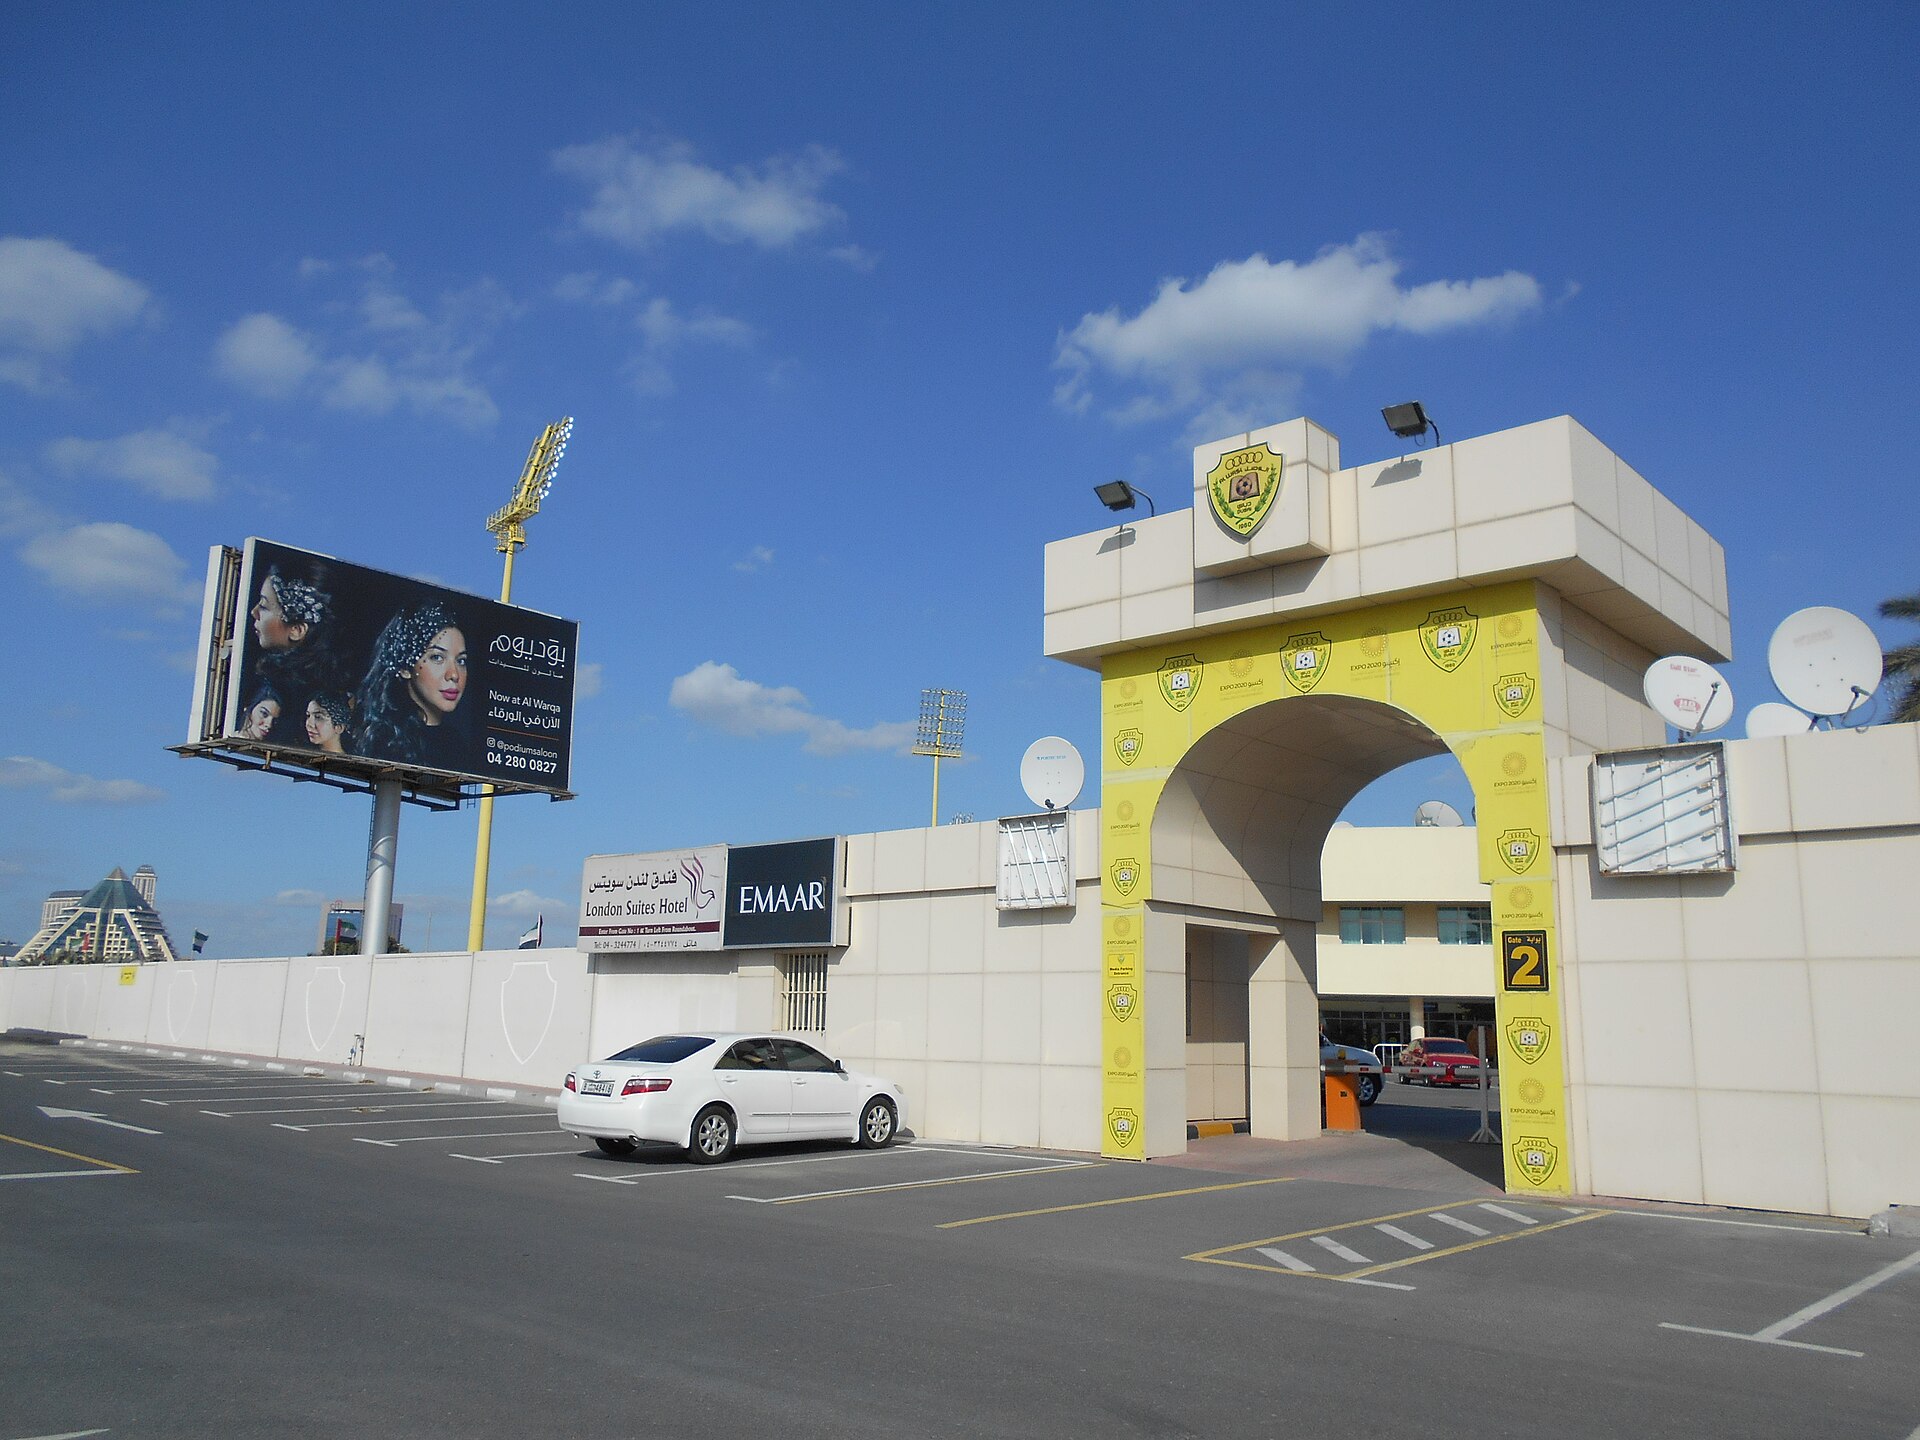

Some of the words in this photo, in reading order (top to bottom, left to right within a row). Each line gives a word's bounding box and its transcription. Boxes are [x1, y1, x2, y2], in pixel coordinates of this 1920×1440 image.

[489, 690, 510, 702] Now
[512, 696, 520, 705] at
[533, 699, 560, 714] Warqa
[488, 706, 521, 722] الورقاء
[522, 715, 540, 727] في
[542, 717, 560, 729] الآن
[497, 740, 558, 758] @podiumsaloon
[487, 752, 502, 764] 04
[505, 755, 526, 768] 280
[529, 759, 556, 773] 0827
[589, 875, 624, 893] سويتس
[626, 872, 649, 890] لندن
[651, 869, 677, 890] فندق
[586, 902, 622, 917] London
[626, 900, 655, 915] Suites
[659, 897, 688, 914] Hotel
[740, 882, 824, 914] EMAAR
[1511, 945, 1540, 985] 2
